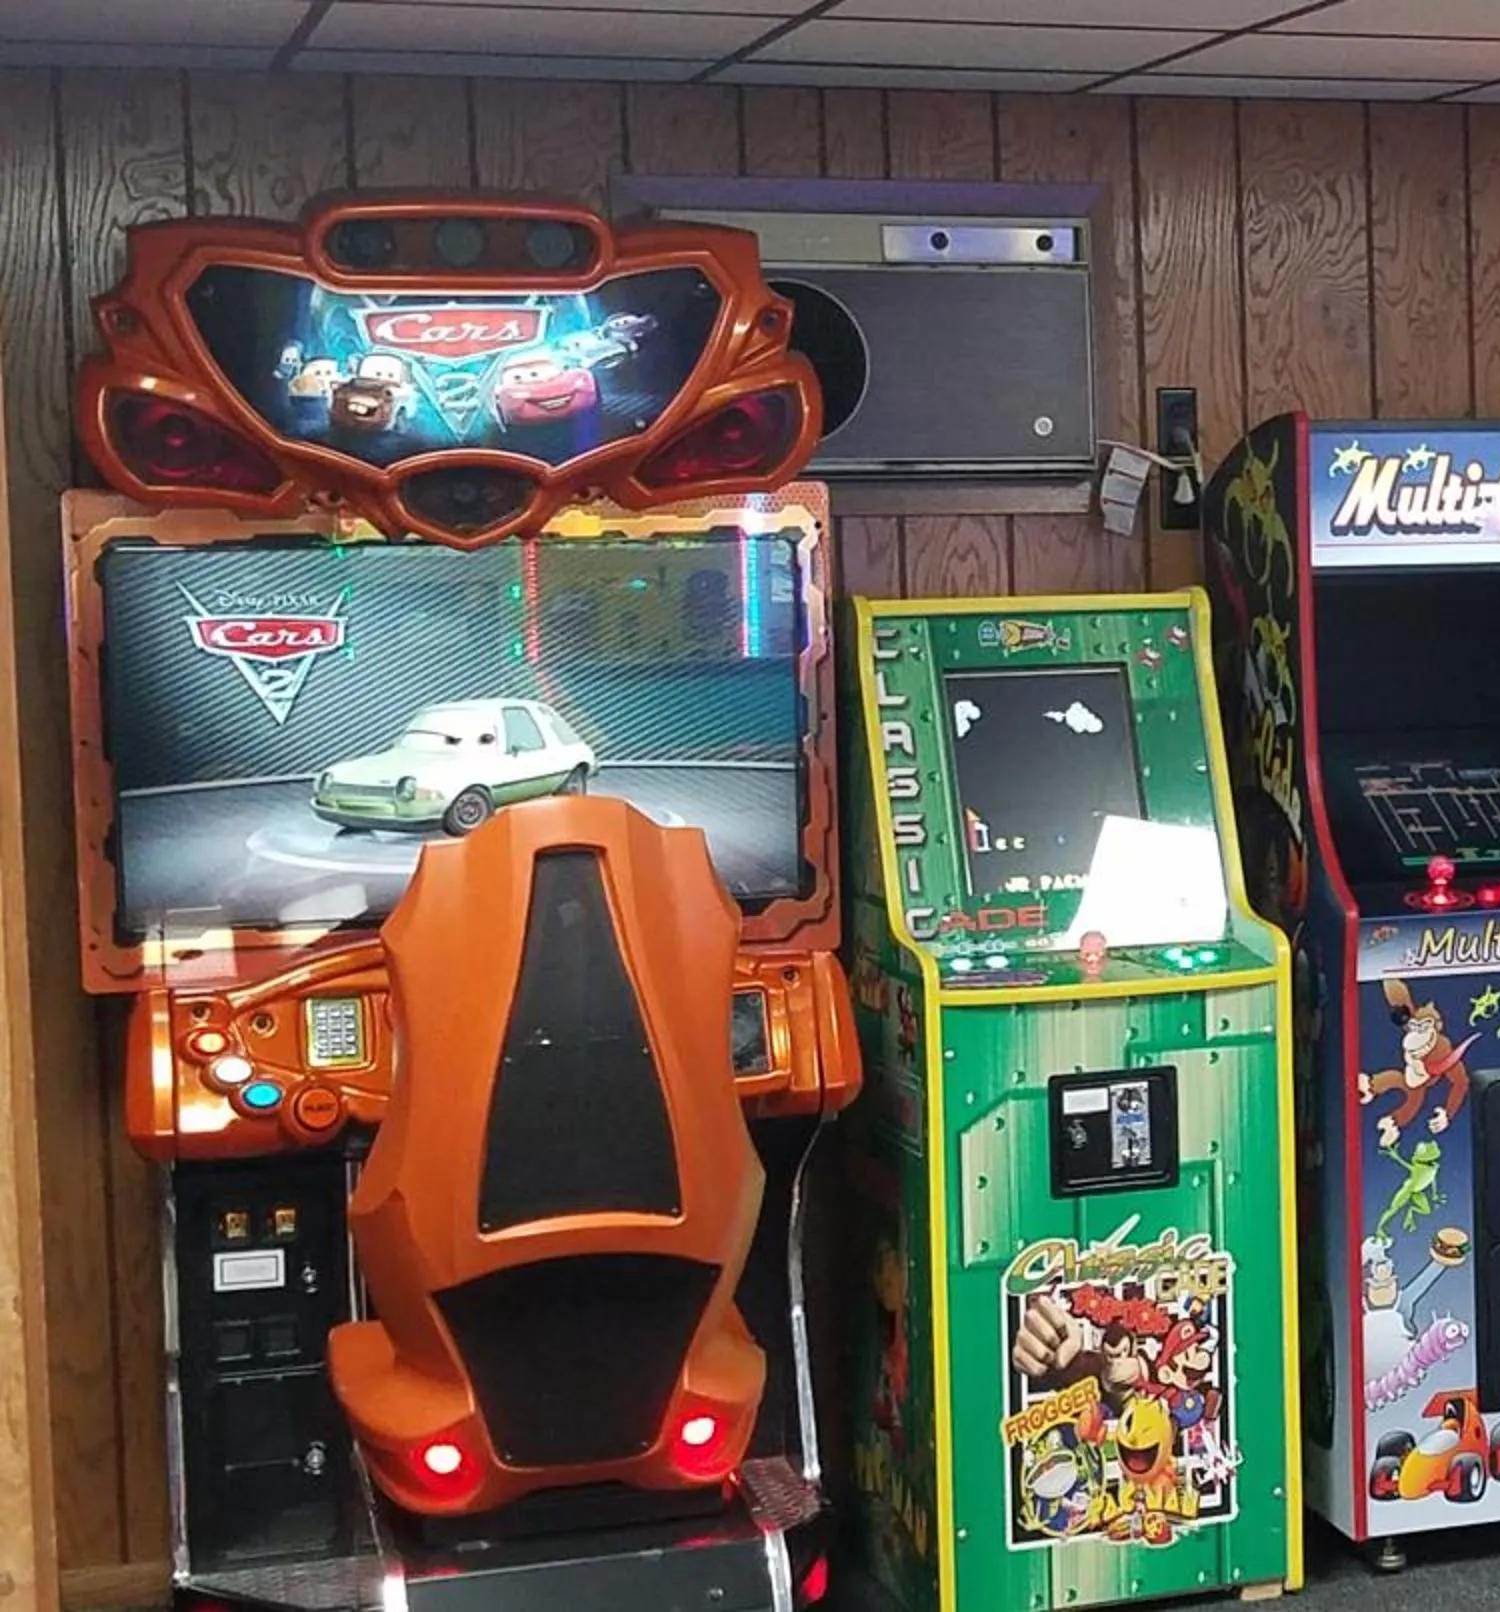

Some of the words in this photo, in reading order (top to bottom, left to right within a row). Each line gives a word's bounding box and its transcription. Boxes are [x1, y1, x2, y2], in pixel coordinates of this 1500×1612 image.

[375, 312, 527, 344] Cars
[211, 620, 333, 648] Cars
[261, 669, 298, 700] 2
[1003, 1383, 1098, 1443] FROGGER
